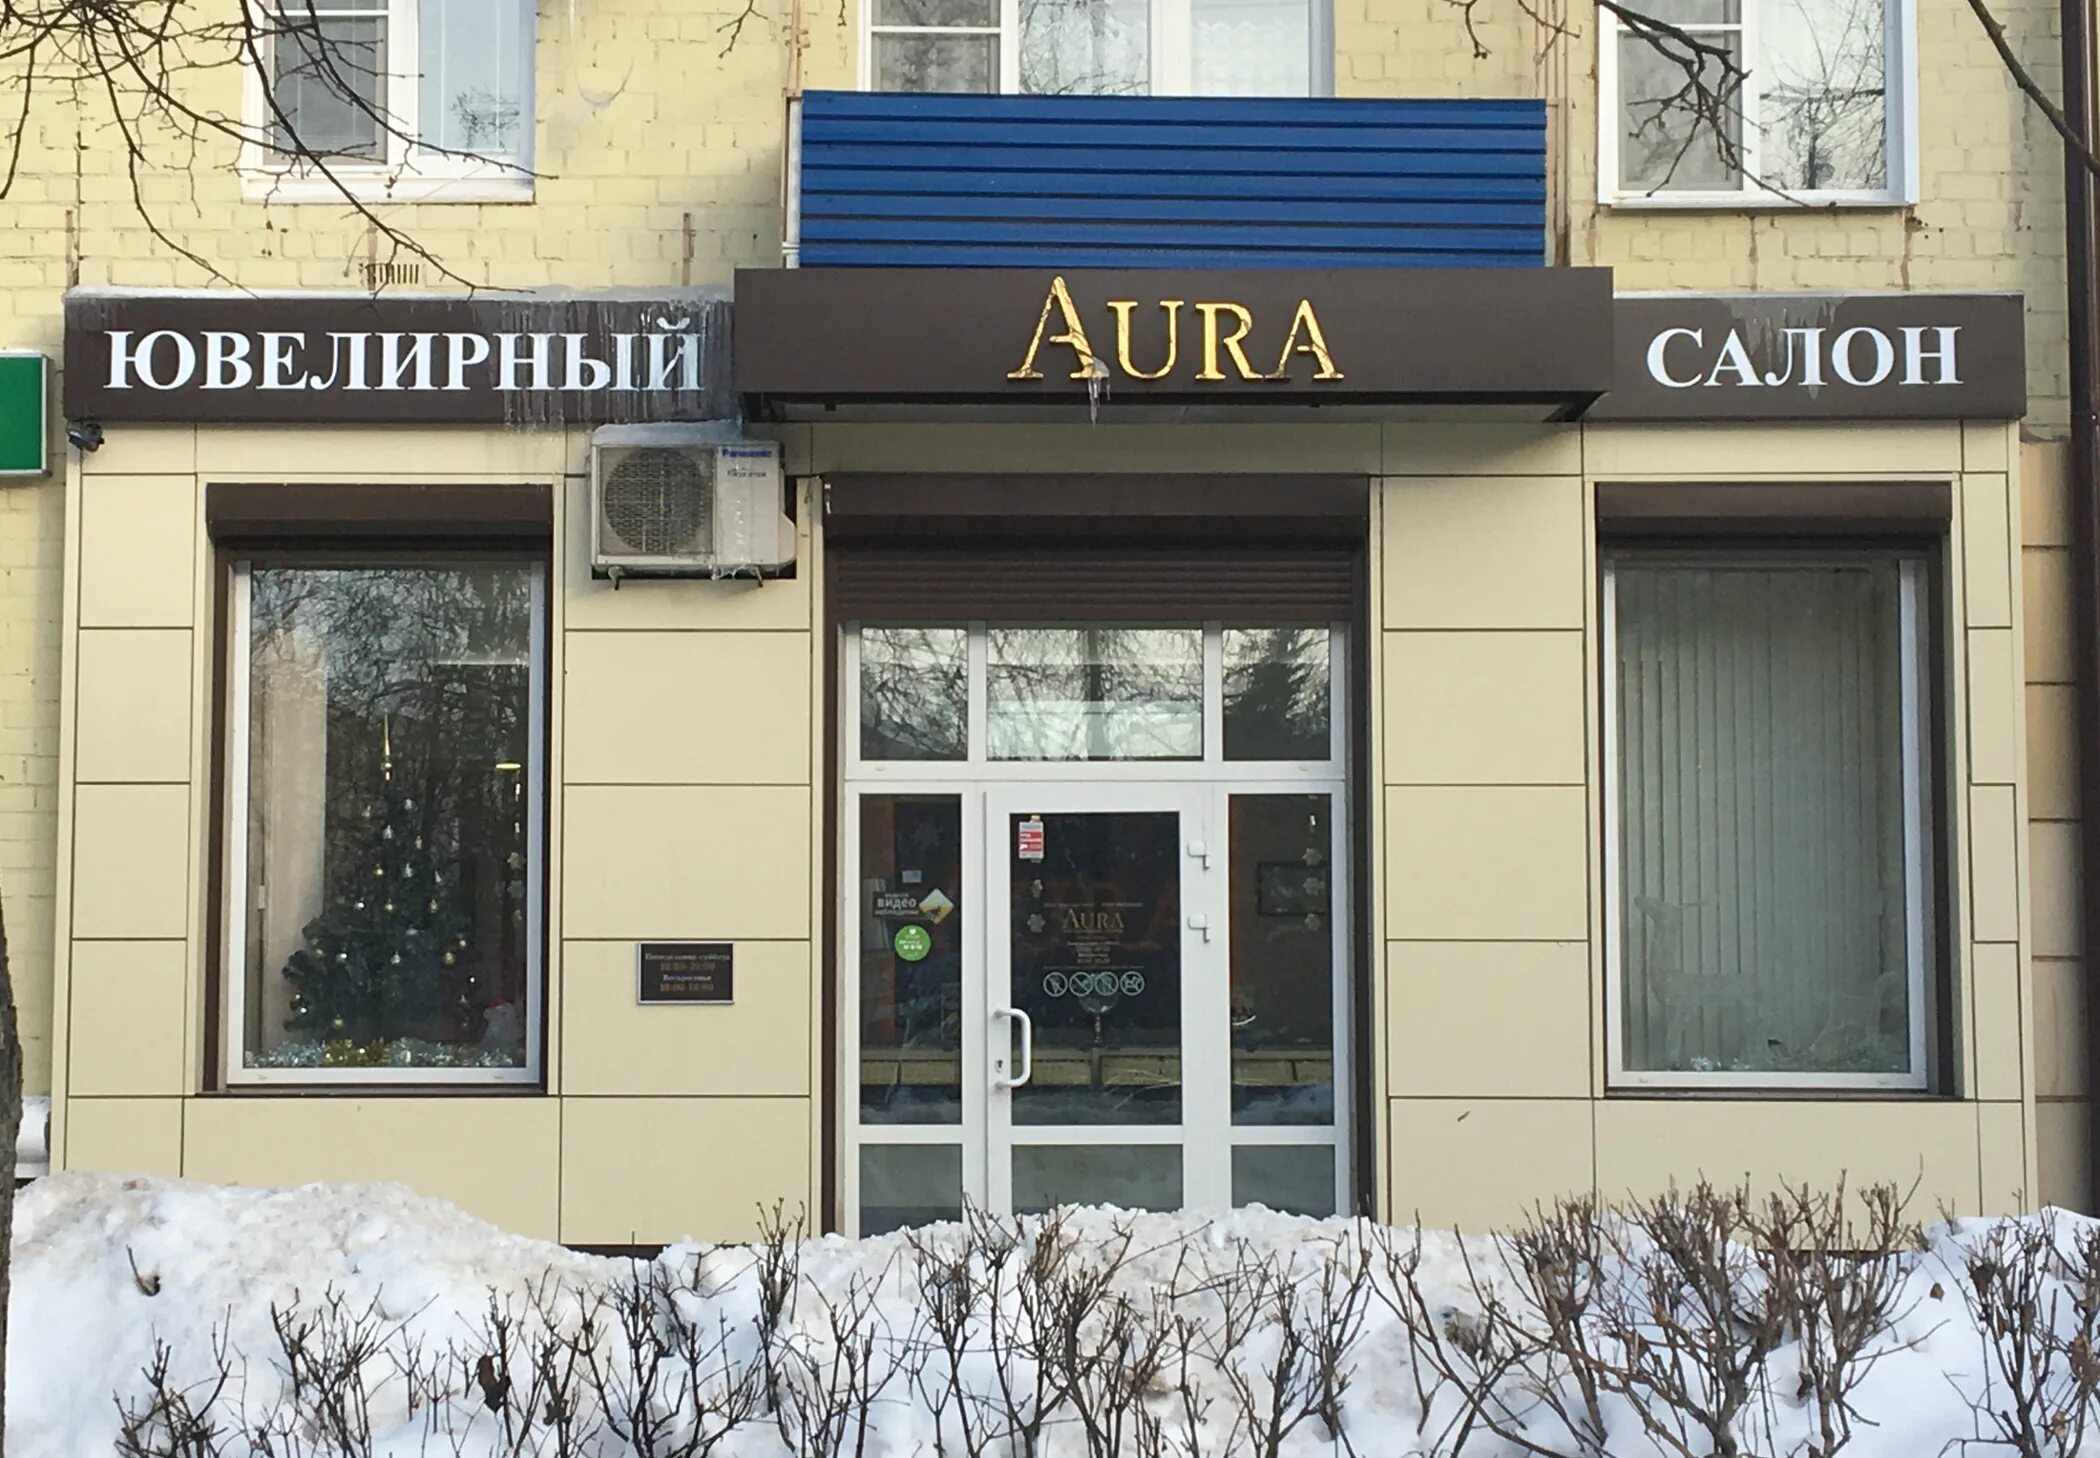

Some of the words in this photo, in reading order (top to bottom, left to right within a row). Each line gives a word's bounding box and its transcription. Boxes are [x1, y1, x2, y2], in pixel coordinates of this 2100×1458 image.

[104, 316, 705, 391] ЮВЕЛИРНЫЙ
[1006, 276, 1344, 381] AURA
[1646, 326, 1964, 388] САЛОН
[1062, 907, 1125, 929] AURA
